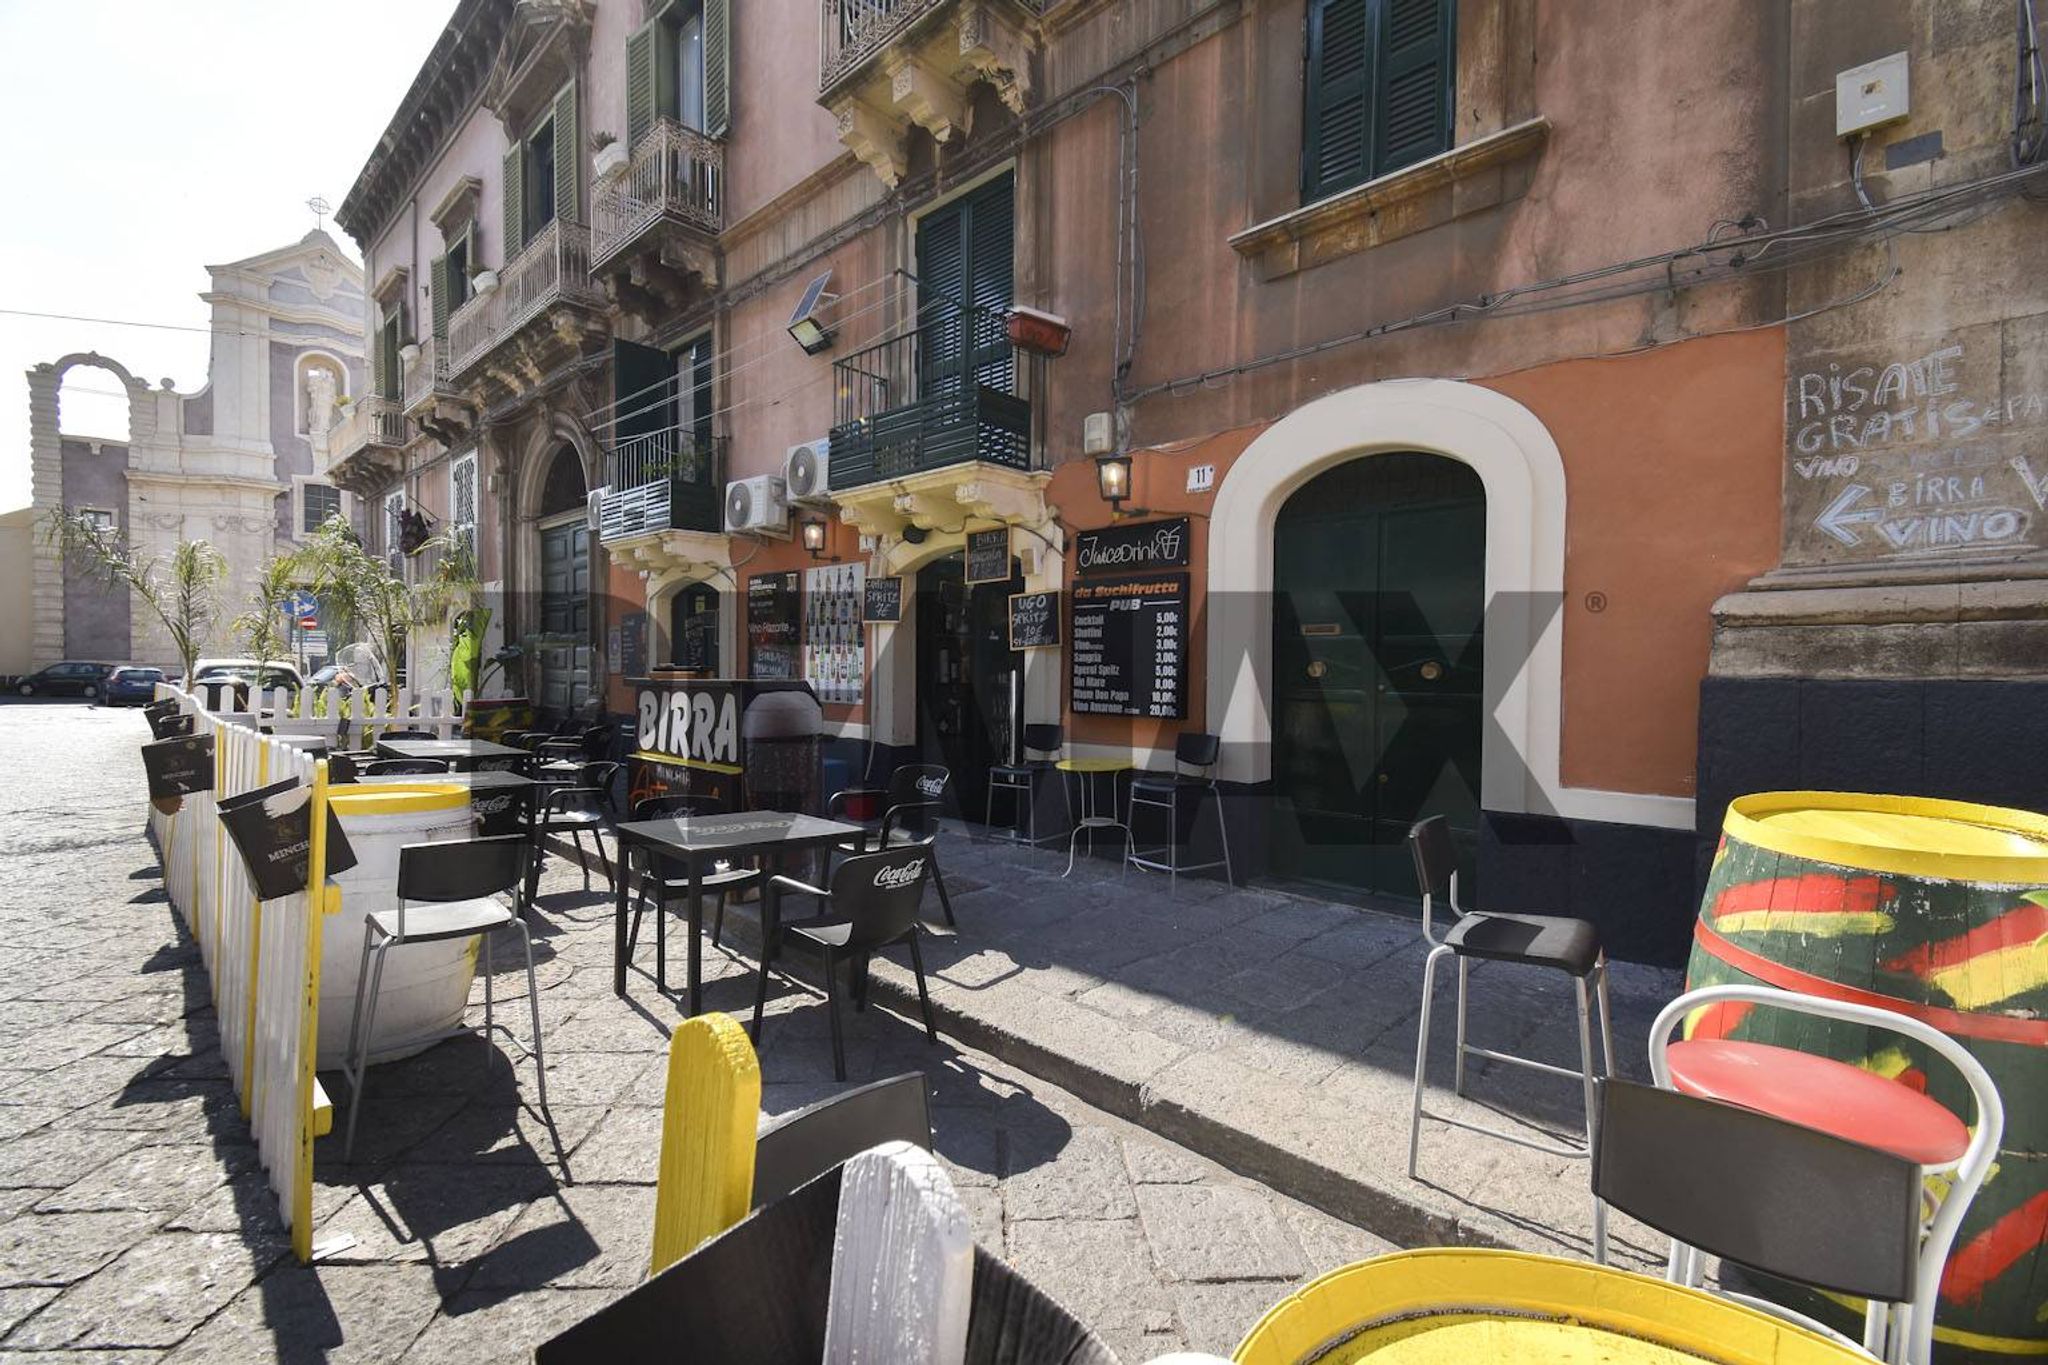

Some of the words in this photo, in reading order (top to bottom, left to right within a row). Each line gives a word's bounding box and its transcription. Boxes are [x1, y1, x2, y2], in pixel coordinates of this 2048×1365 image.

[1018, 595, 1047, 609] UGO
[1109, 599, 1141, 611] PUB
[638, 690, 738, 763] BIRRA
[267, 841, 309, 863] MINCH
[873, 857, 926, 887] Coca-Cola
